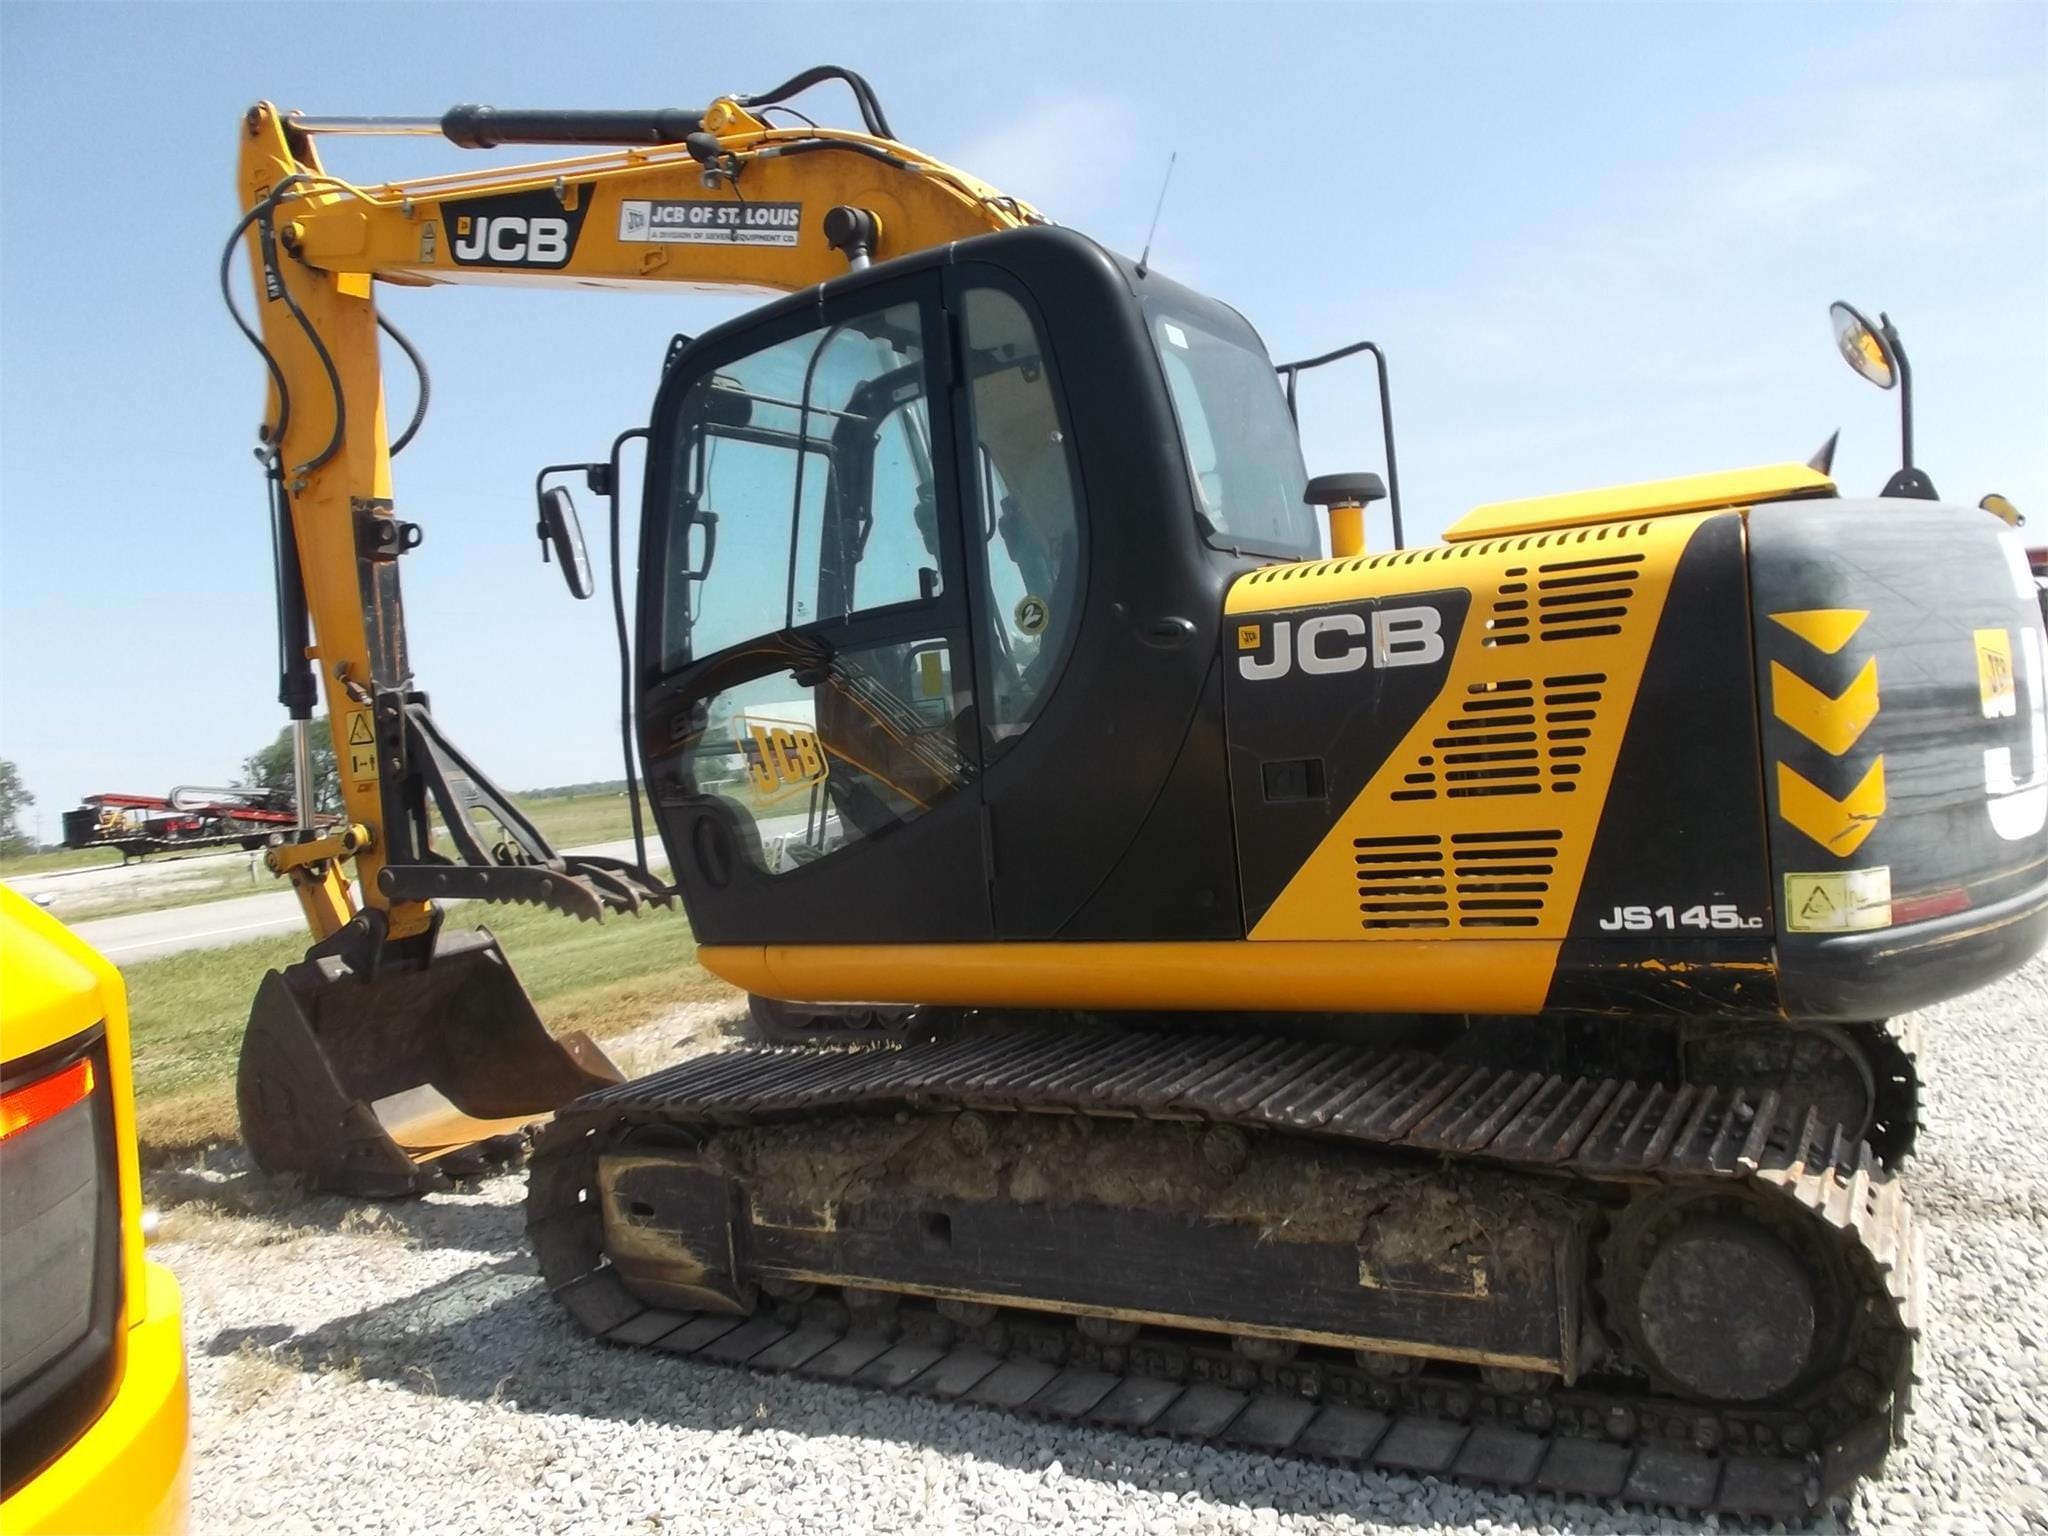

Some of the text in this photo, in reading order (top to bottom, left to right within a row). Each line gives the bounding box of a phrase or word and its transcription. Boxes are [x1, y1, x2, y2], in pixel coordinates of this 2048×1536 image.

[455, 216, 568, 262] JCB
[652, 206, 799, 226] JCB OF ST. LOUIS
[1239, 606, 1445, 680] JCB
[749, 725, 821, 794] JCB
